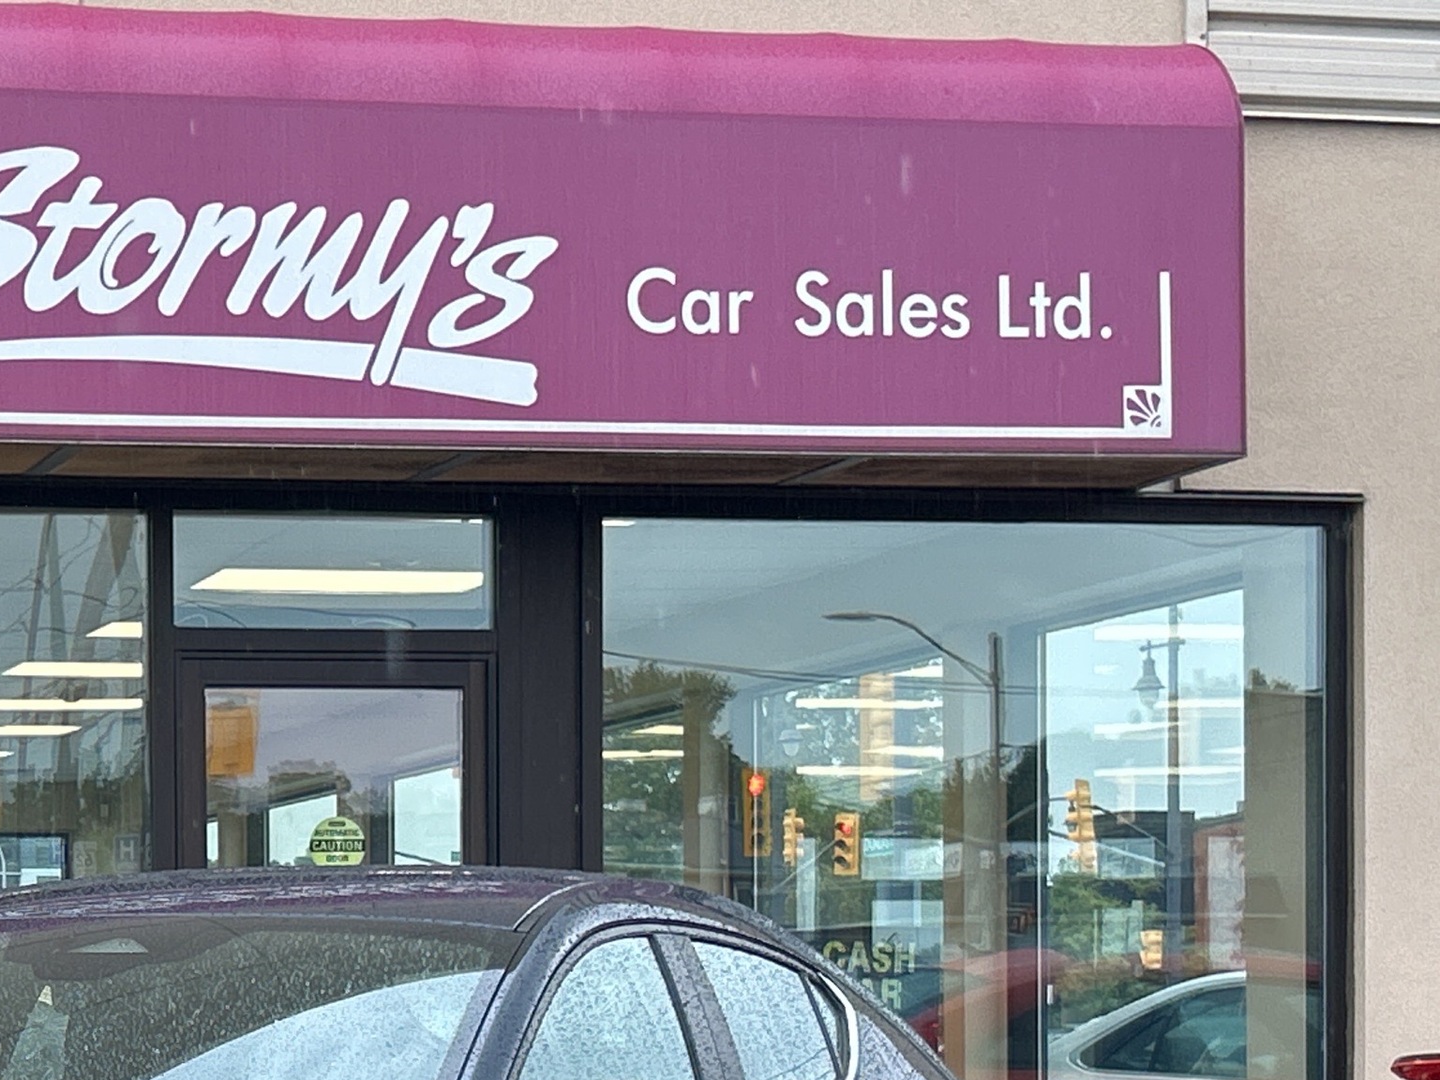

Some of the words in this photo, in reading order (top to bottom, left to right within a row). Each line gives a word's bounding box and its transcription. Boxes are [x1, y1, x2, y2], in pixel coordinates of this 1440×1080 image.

[627, 267, 754, 334] Car
[794, 269, 971, 338] Sales
[998, 272, 1113, 340] Ltd.
[312, 841, 363, 851] CAUTION
[823, 940, 916, 974] CASH
